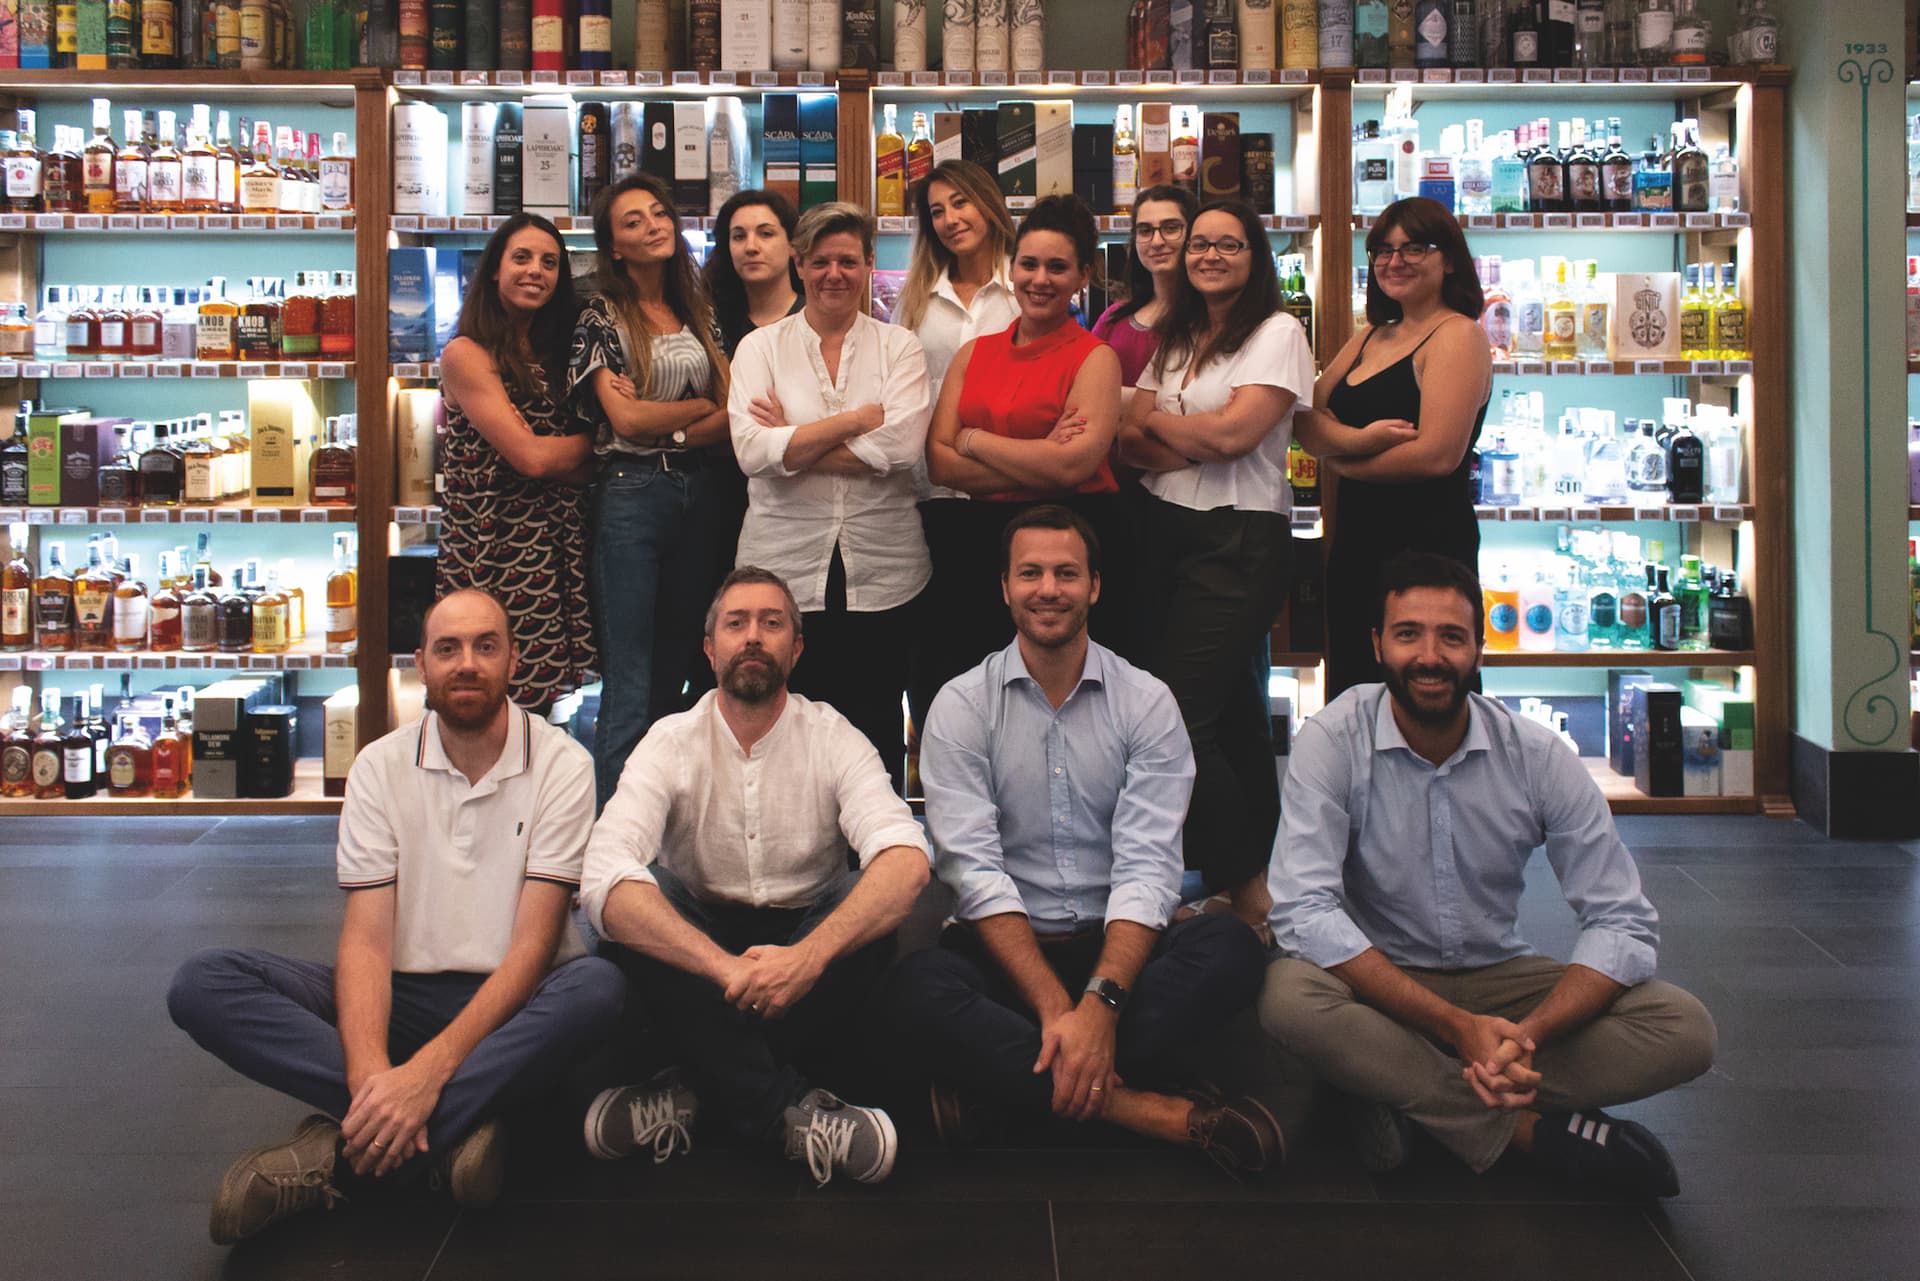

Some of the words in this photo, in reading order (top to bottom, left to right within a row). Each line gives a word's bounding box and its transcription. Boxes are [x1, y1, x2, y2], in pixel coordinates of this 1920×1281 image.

[1844, 43, 1888, 54] 1933
[764, 130, 796, 139] SCAPA
[802, 130, 834, 139] SCAPA
[540, 160, 551, 170] 25
[199, 315, 224, 326] KNOB
[239, 315, 264, 327] KNOB
[1555, 480, 1582, 495] gin
